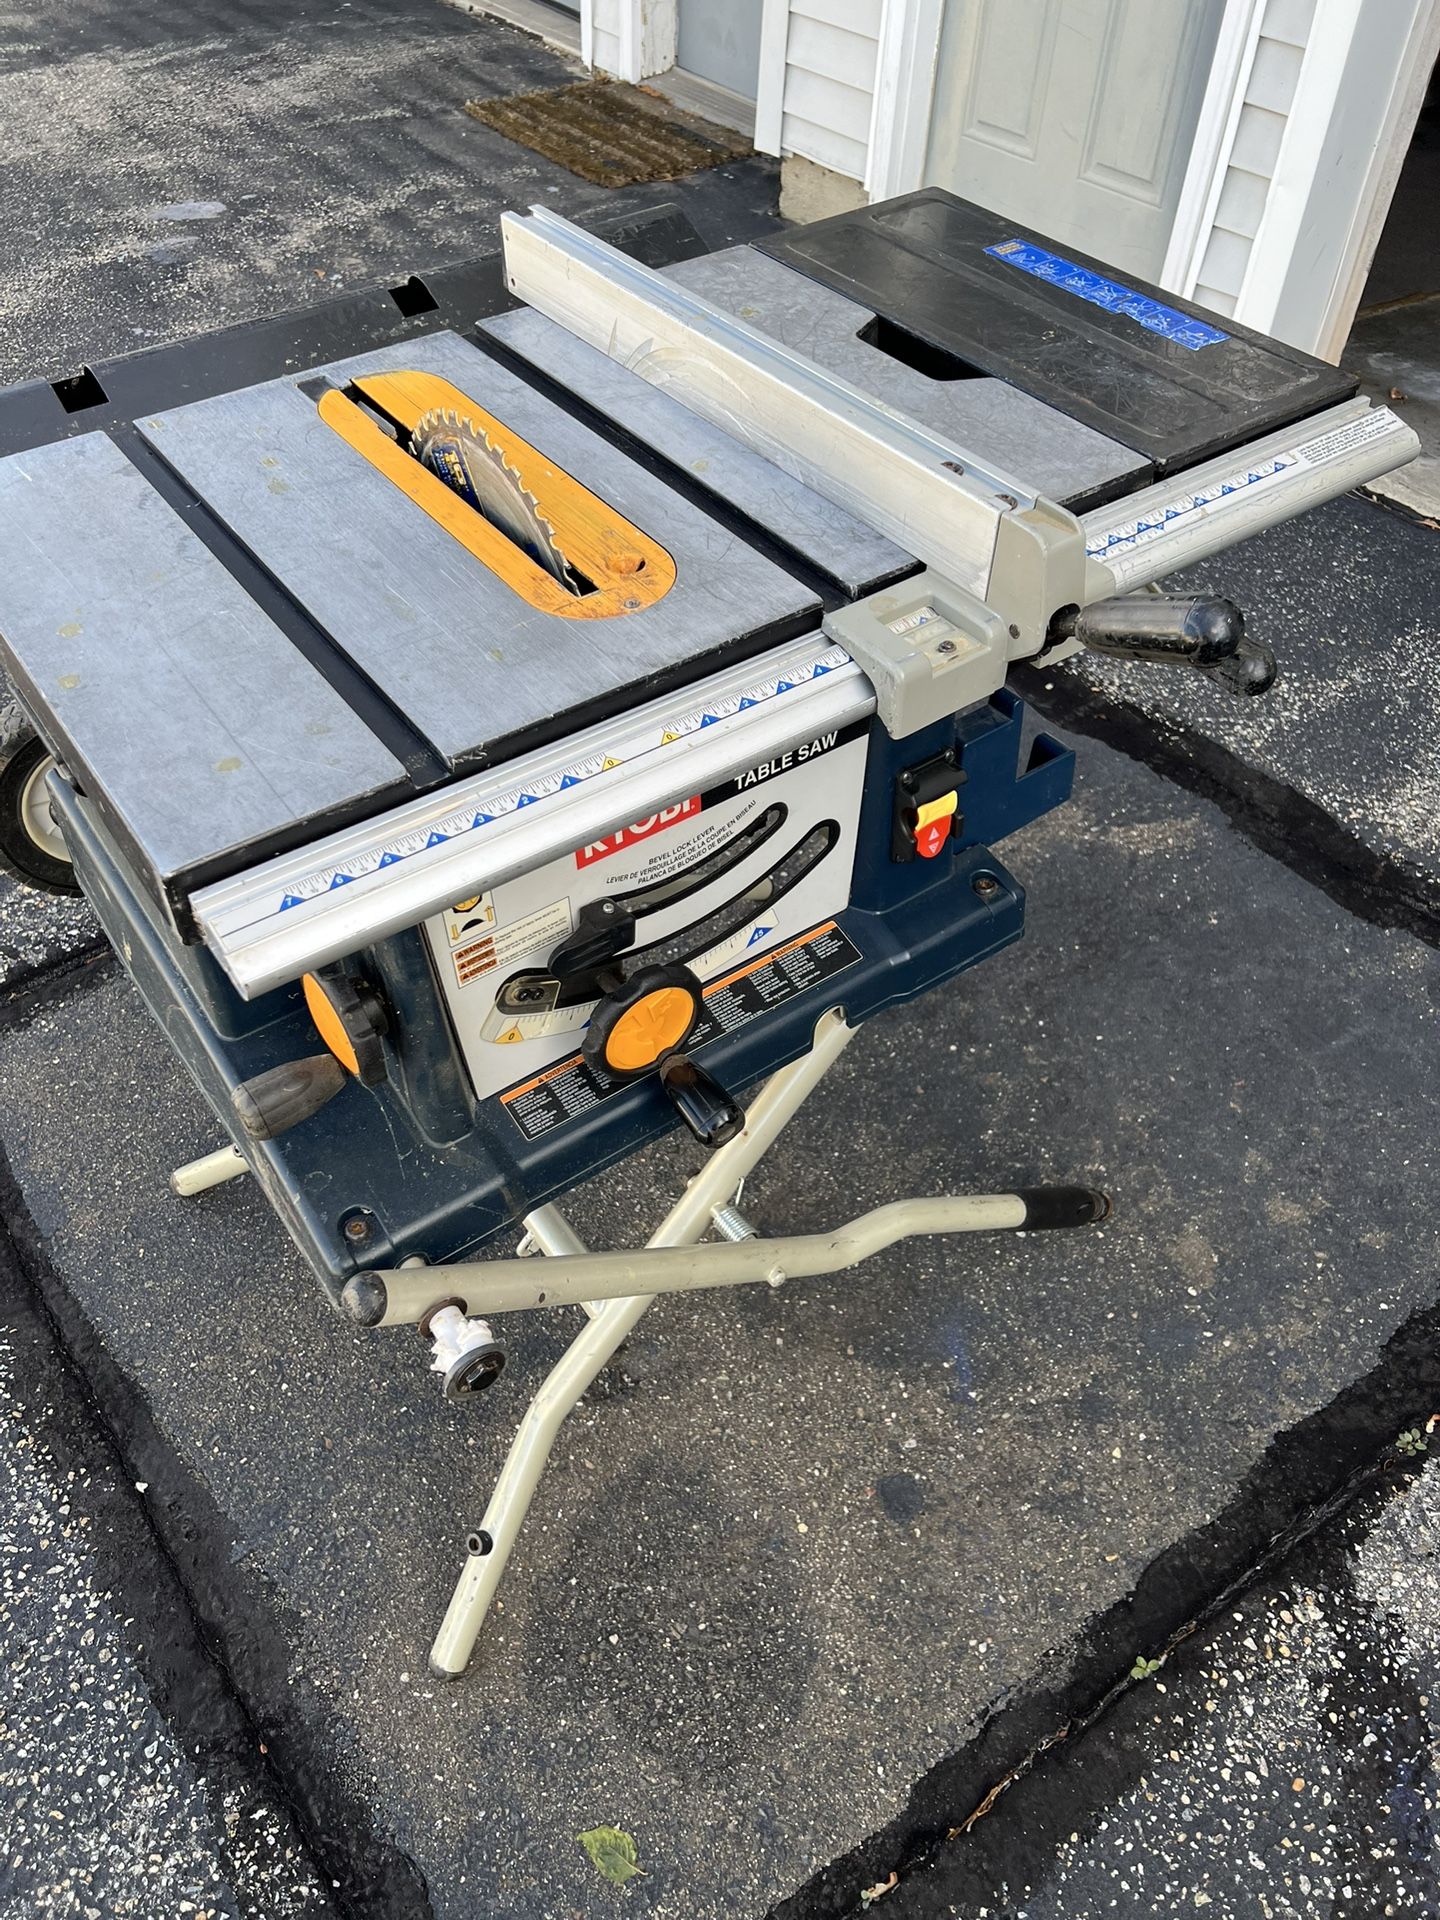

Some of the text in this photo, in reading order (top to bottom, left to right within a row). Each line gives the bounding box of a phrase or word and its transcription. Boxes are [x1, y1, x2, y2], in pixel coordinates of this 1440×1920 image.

[666, 666, 823, 741] 0 1 2 3 4
[734, 730, 838, 790] TABLE SAW
[285, 758, 614, 906] 7 6 5 4 3 2 1 0
[606, 800, 757, 884] LEVIER DE VERROUILLAGE DE LA COUPE EN BISEAU
[637, 830, 734, 884] PALANCA DE BLOQUEO DE BISEL
[648, 825, 715, 865] BEVEL LOCK LEVER
[753, 929, 765, 941] 45
[507, 1032, 515, 1041] 0
